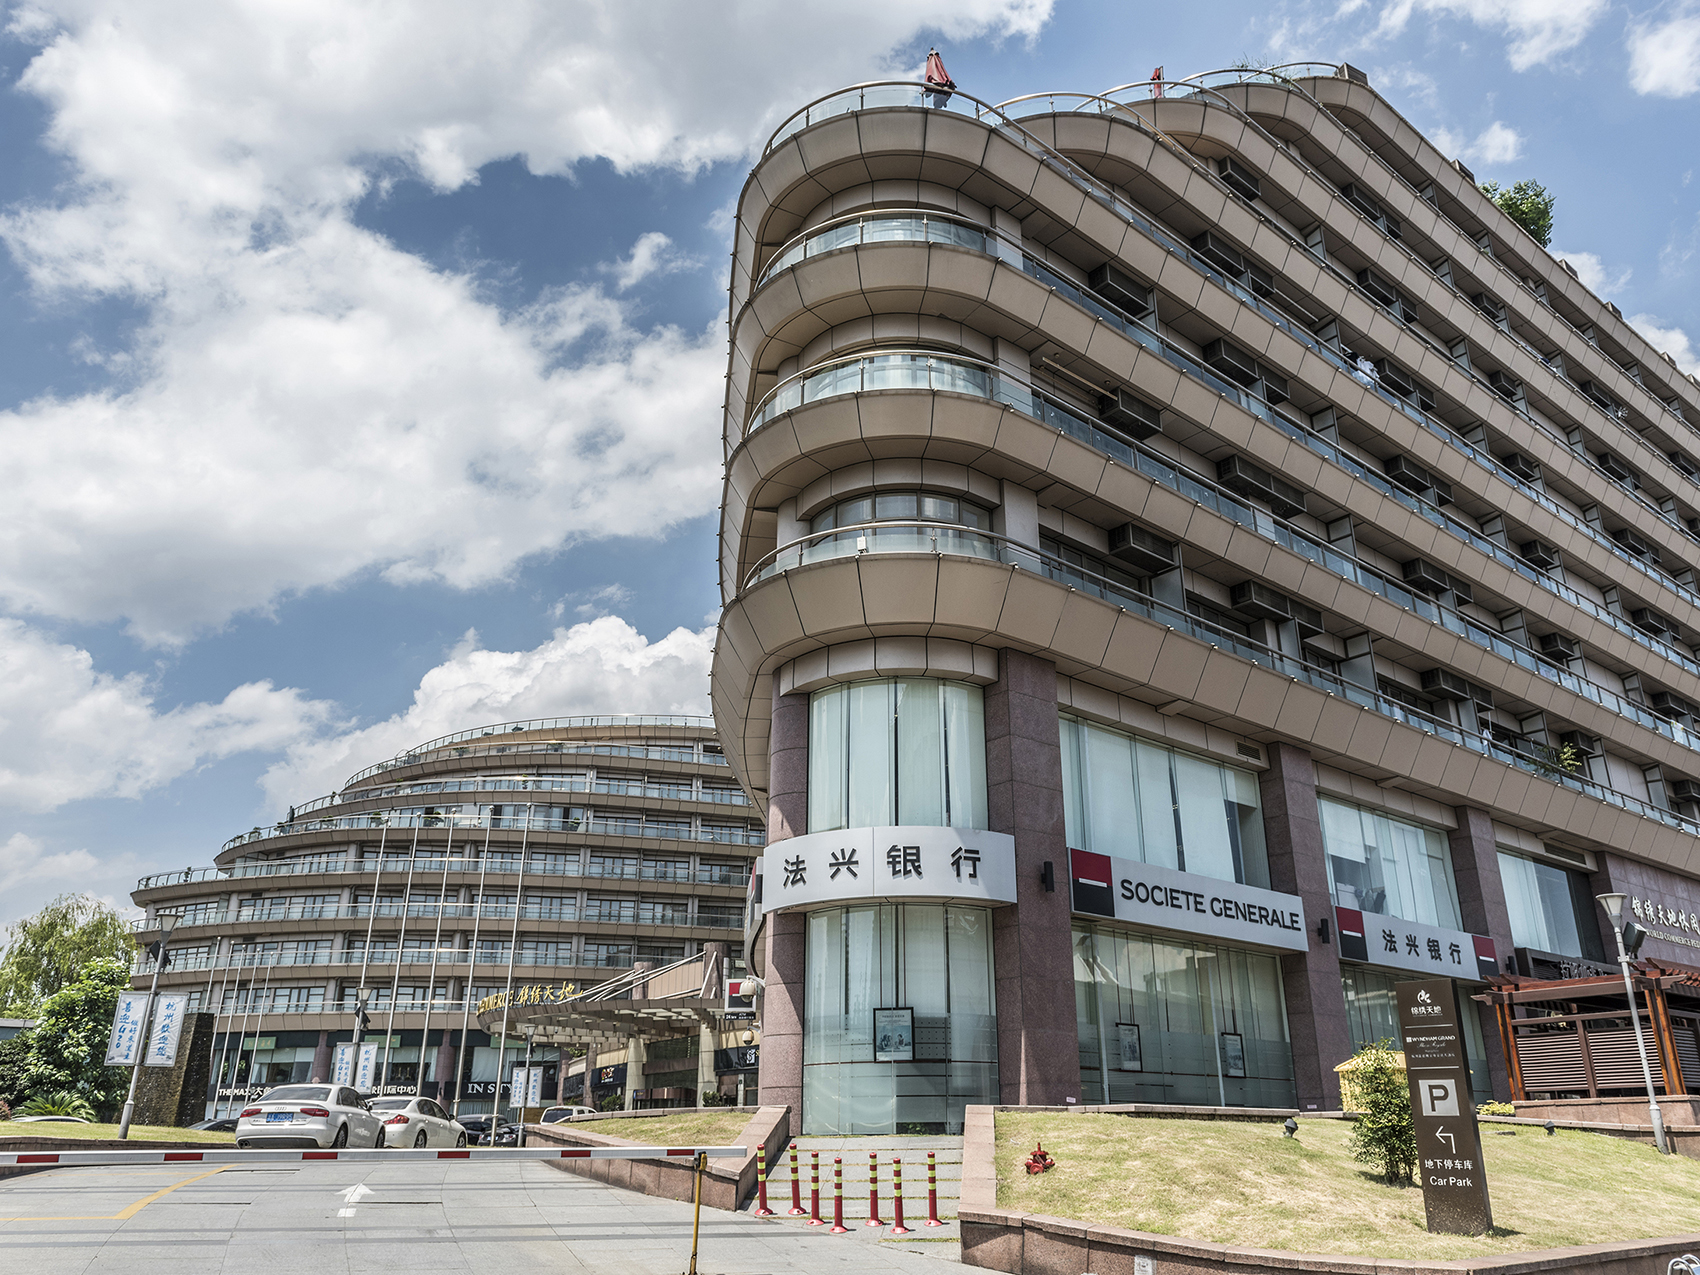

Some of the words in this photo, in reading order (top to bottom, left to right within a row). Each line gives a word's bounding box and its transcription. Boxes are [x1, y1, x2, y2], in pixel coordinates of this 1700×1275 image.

[782, 844, 982, 889] 法兴银行
[1119, 878, 1206, 914] SOCIETE
[1210, 896, 1302, 932] GENERALE
[1382, 929, 1463, 966] 法兴银行
[1410, 1005, 1442, 1015] 锦绣天地
[1428, 1084, 1449, 1112] P
[1424, 1159, 1474, 1170] 地下停车库
[1429, 1175, 1447, 1186] Car
[1449, 1176, 1473, 1187] Park
